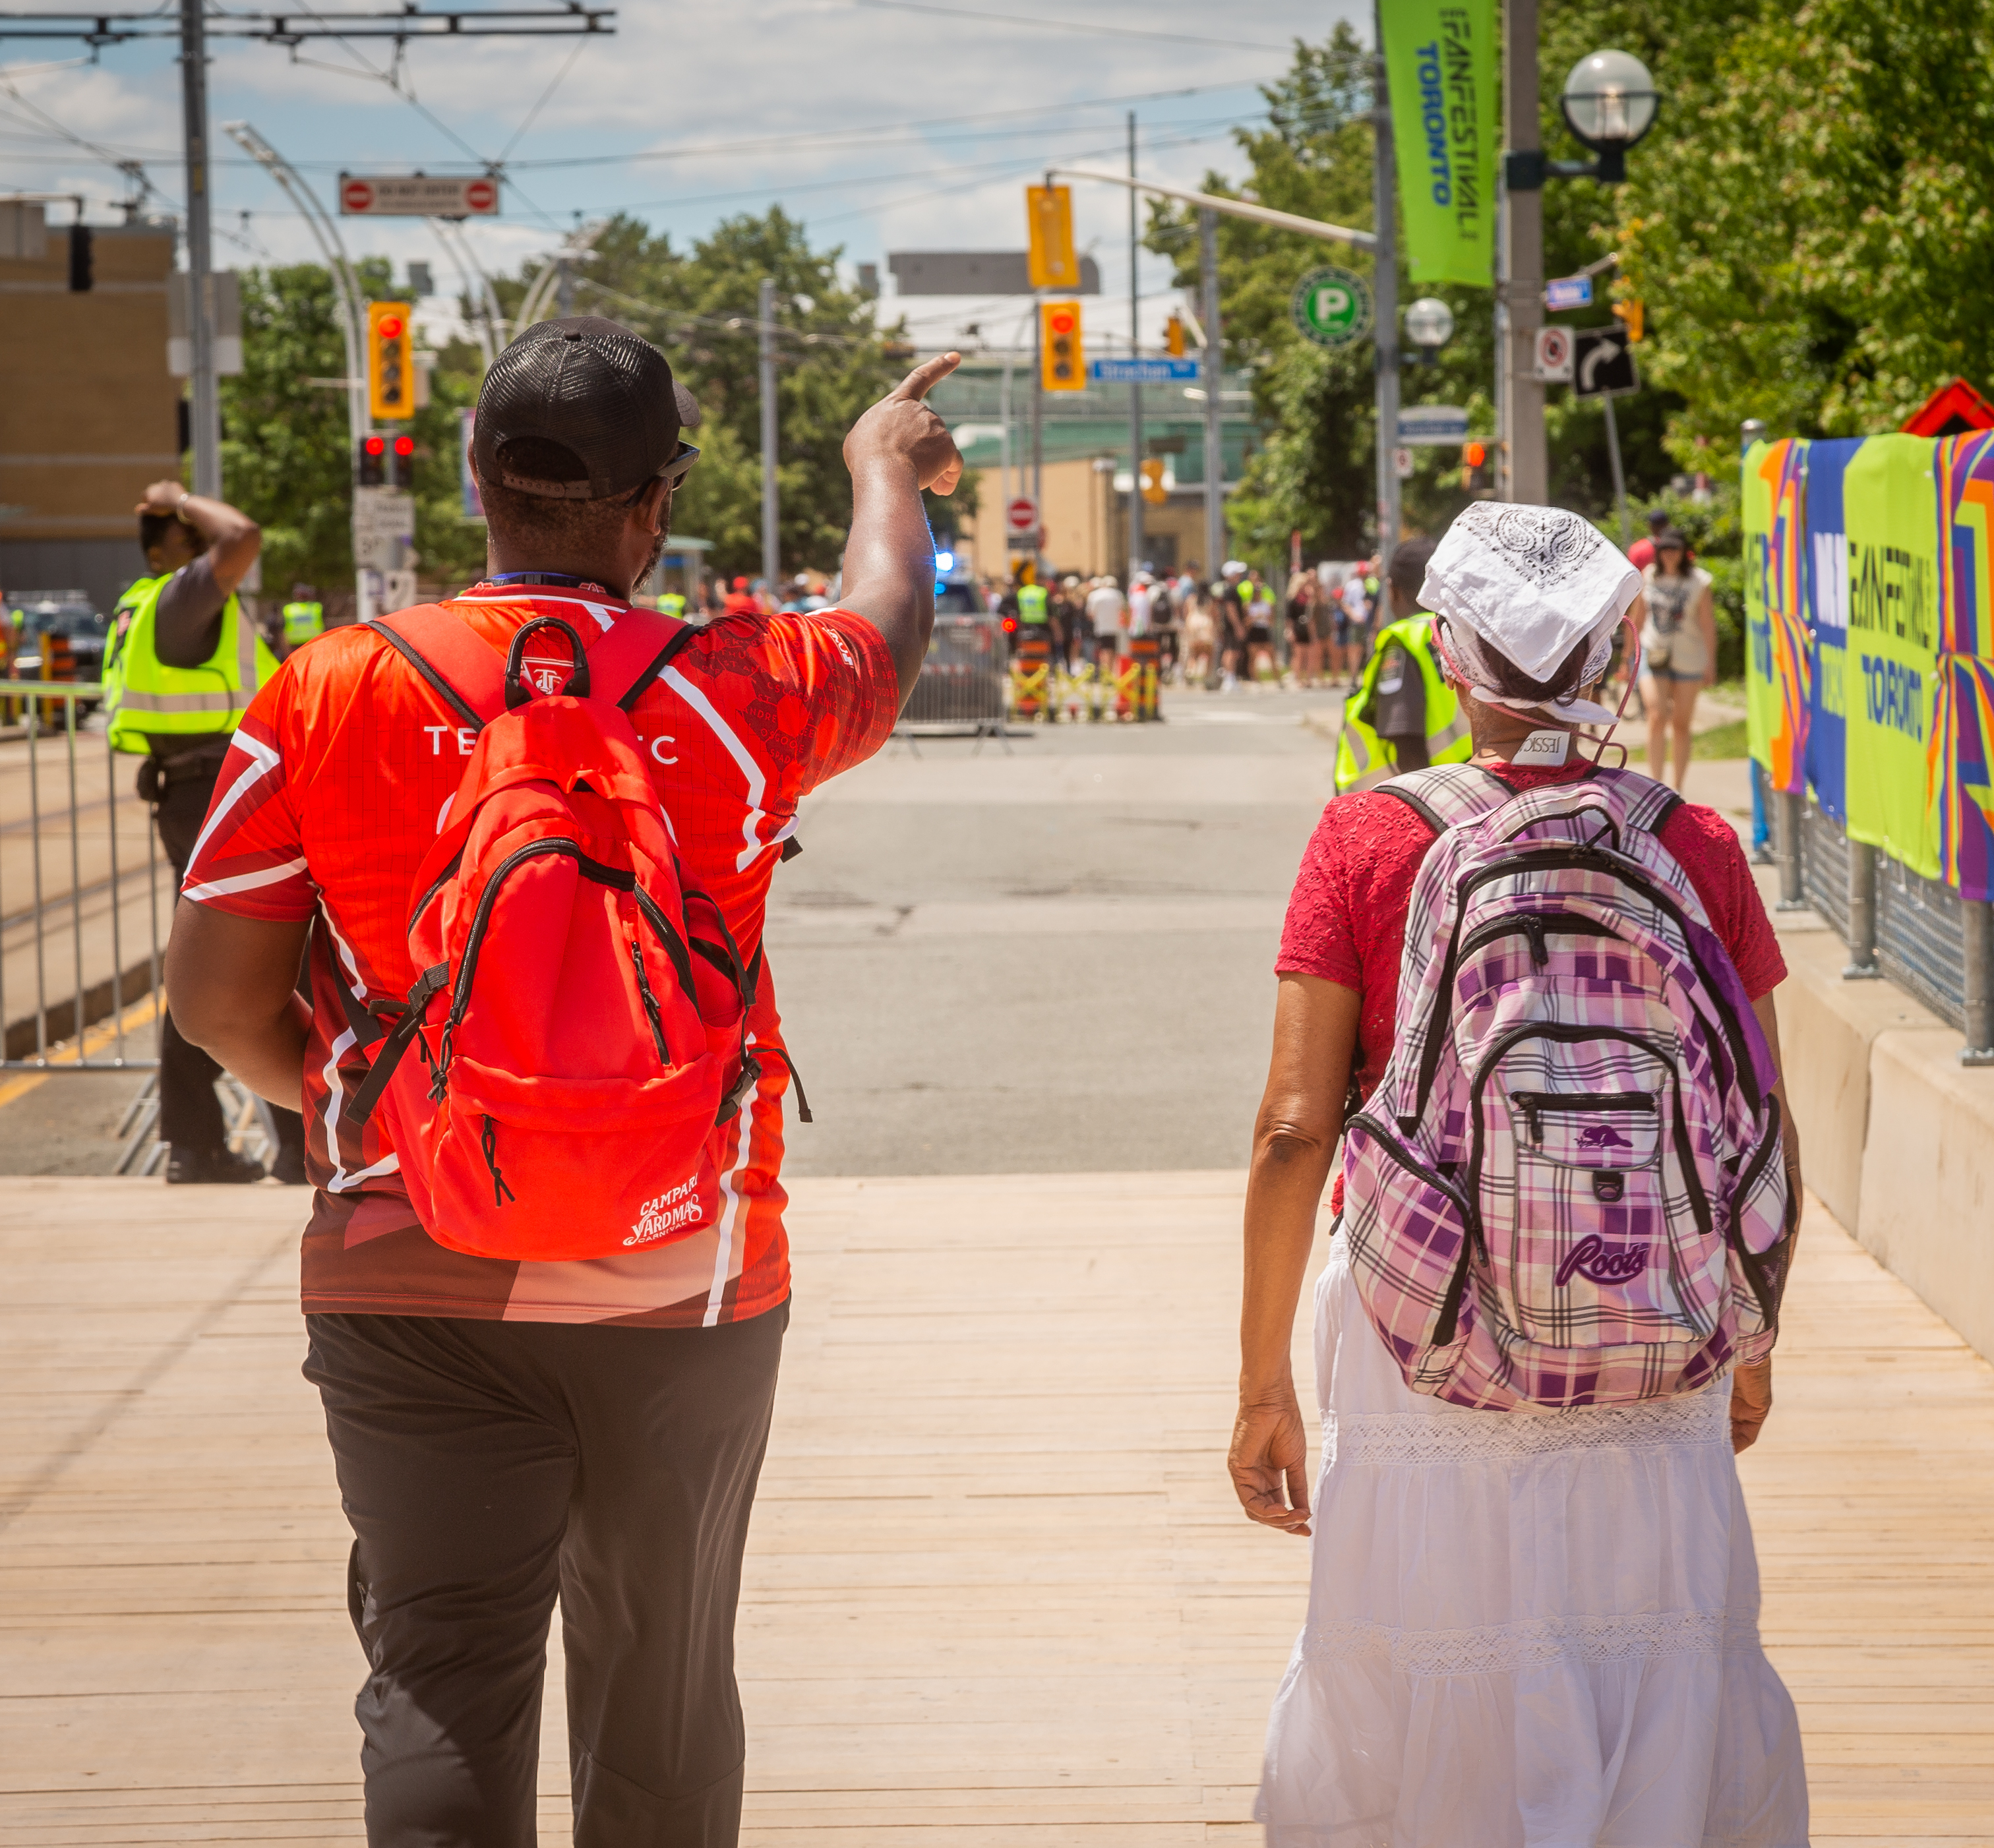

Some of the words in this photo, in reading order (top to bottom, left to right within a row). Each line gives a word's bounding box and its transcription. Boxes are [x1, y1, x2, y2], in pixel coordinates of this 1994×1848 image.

[1416, 41, 1451, 206] TORONTO
[1319, 289, 1348, 320] P
[1519, 736, 1561, 754] JESSIC
[640, 1172, 698, 1216] CAMPARI
[622, 1194, 702, 1246] YARDMAS
[637, 1221, 687, 1243] CARNIVAL
[1555, 1233, 1648, 1287] Roots
